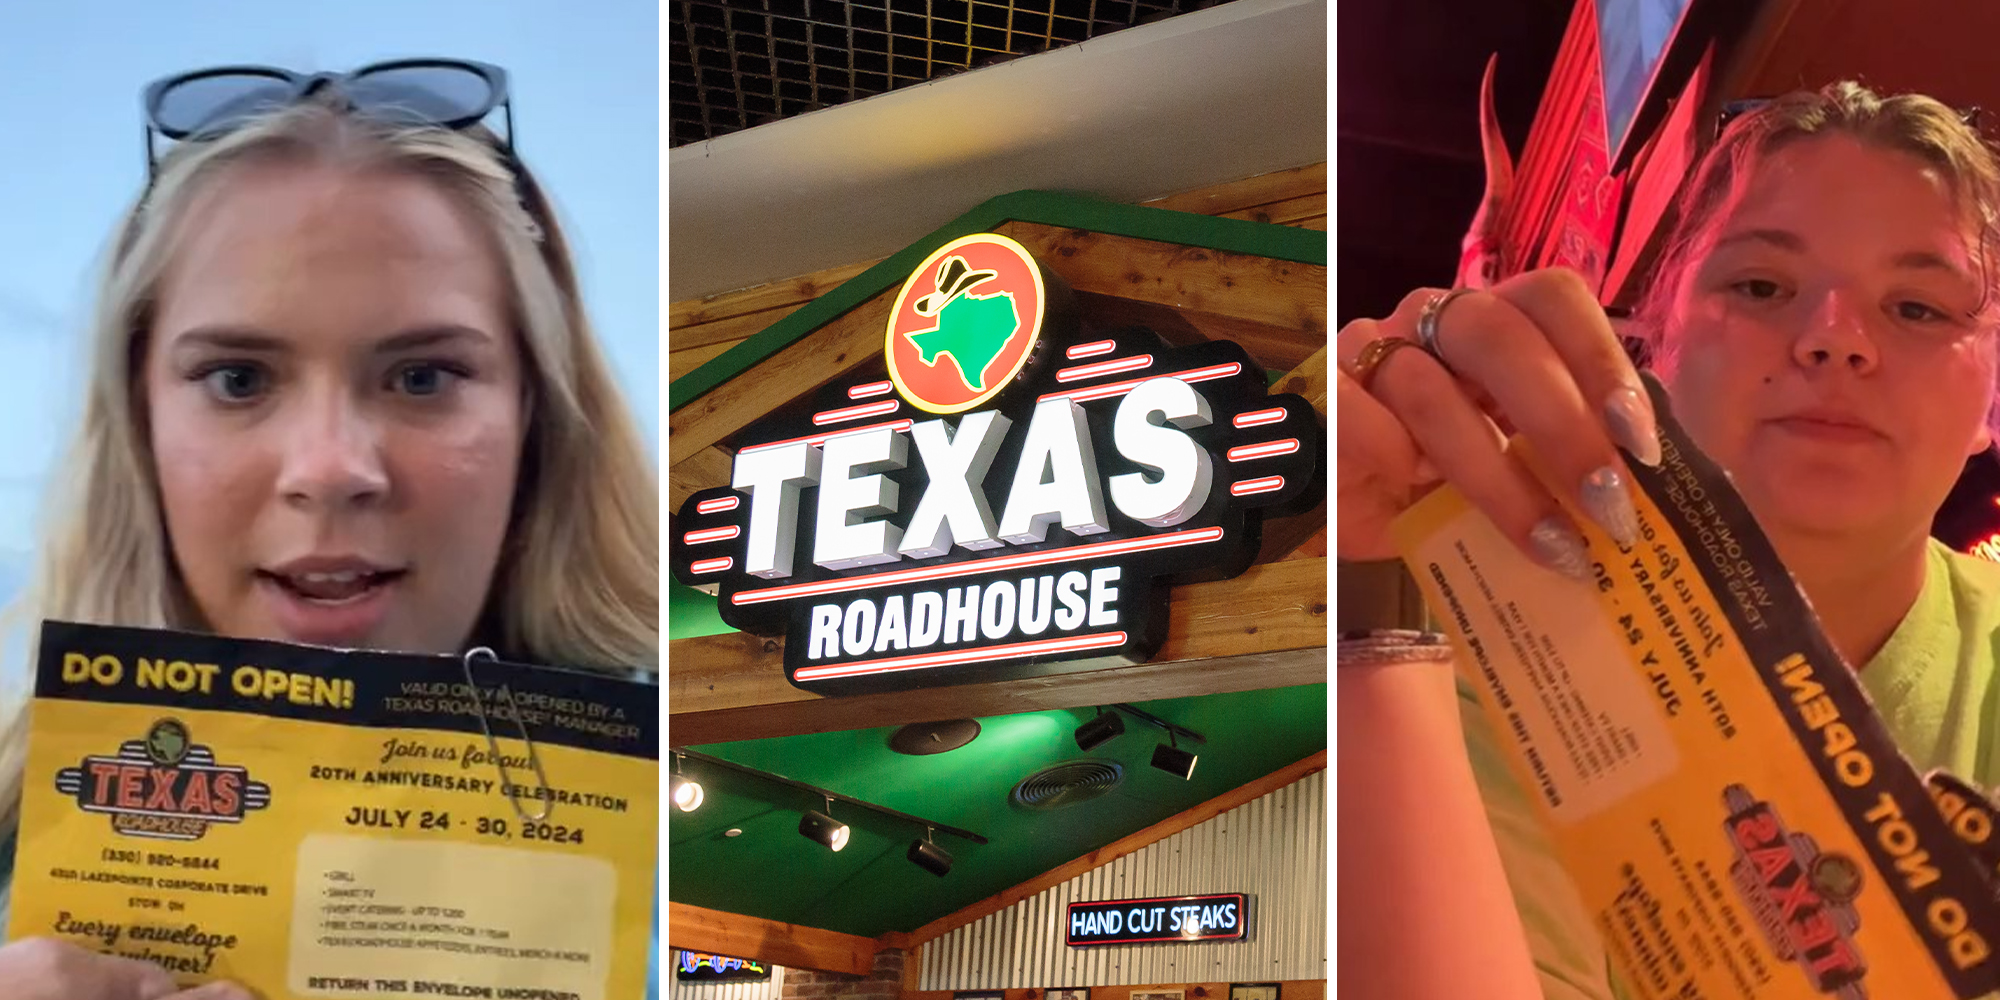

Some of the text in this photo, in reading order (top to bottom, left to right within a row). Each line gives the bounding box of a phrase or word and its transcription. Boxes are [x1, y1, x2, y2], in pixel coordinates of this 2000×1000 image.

[731, 376, 1212, 578] TEXAS
[807, 566, 1123, 660] ROADHOUSE
[61, 652, 355, 709] DO NOT OPEN!
[400, 681, 448, 696] VALID
[514, 691, 585, 714] OPENED
[587, 702, 610, 719] BY
[610, 706, 626, 719] A
[384, 697, 434, 713] TEXAS
[553, 714, 641, 739] MANAGER
[381, 738, 428, 764] Join
[431, 746, 457, 761] us
[89, 764, 243, 817] TEXAS
[309, 765, 357, 782] 20TH
[363, 771, 494, 795] ANNIVERSARY
[345, 807, 411, 830] JULY
[420, 811, 451, 830] 24
[521, 822, 585, 845] 2024
[54, 910, 238, 955] Every envelope
[1071, 903, 1237, 937] HAND CUT STEAKS
[308, 977, 369, 990] RETURN
[375, 980, 407, 992] THIS
[413, 981, 492, 999] ENVELOPE
